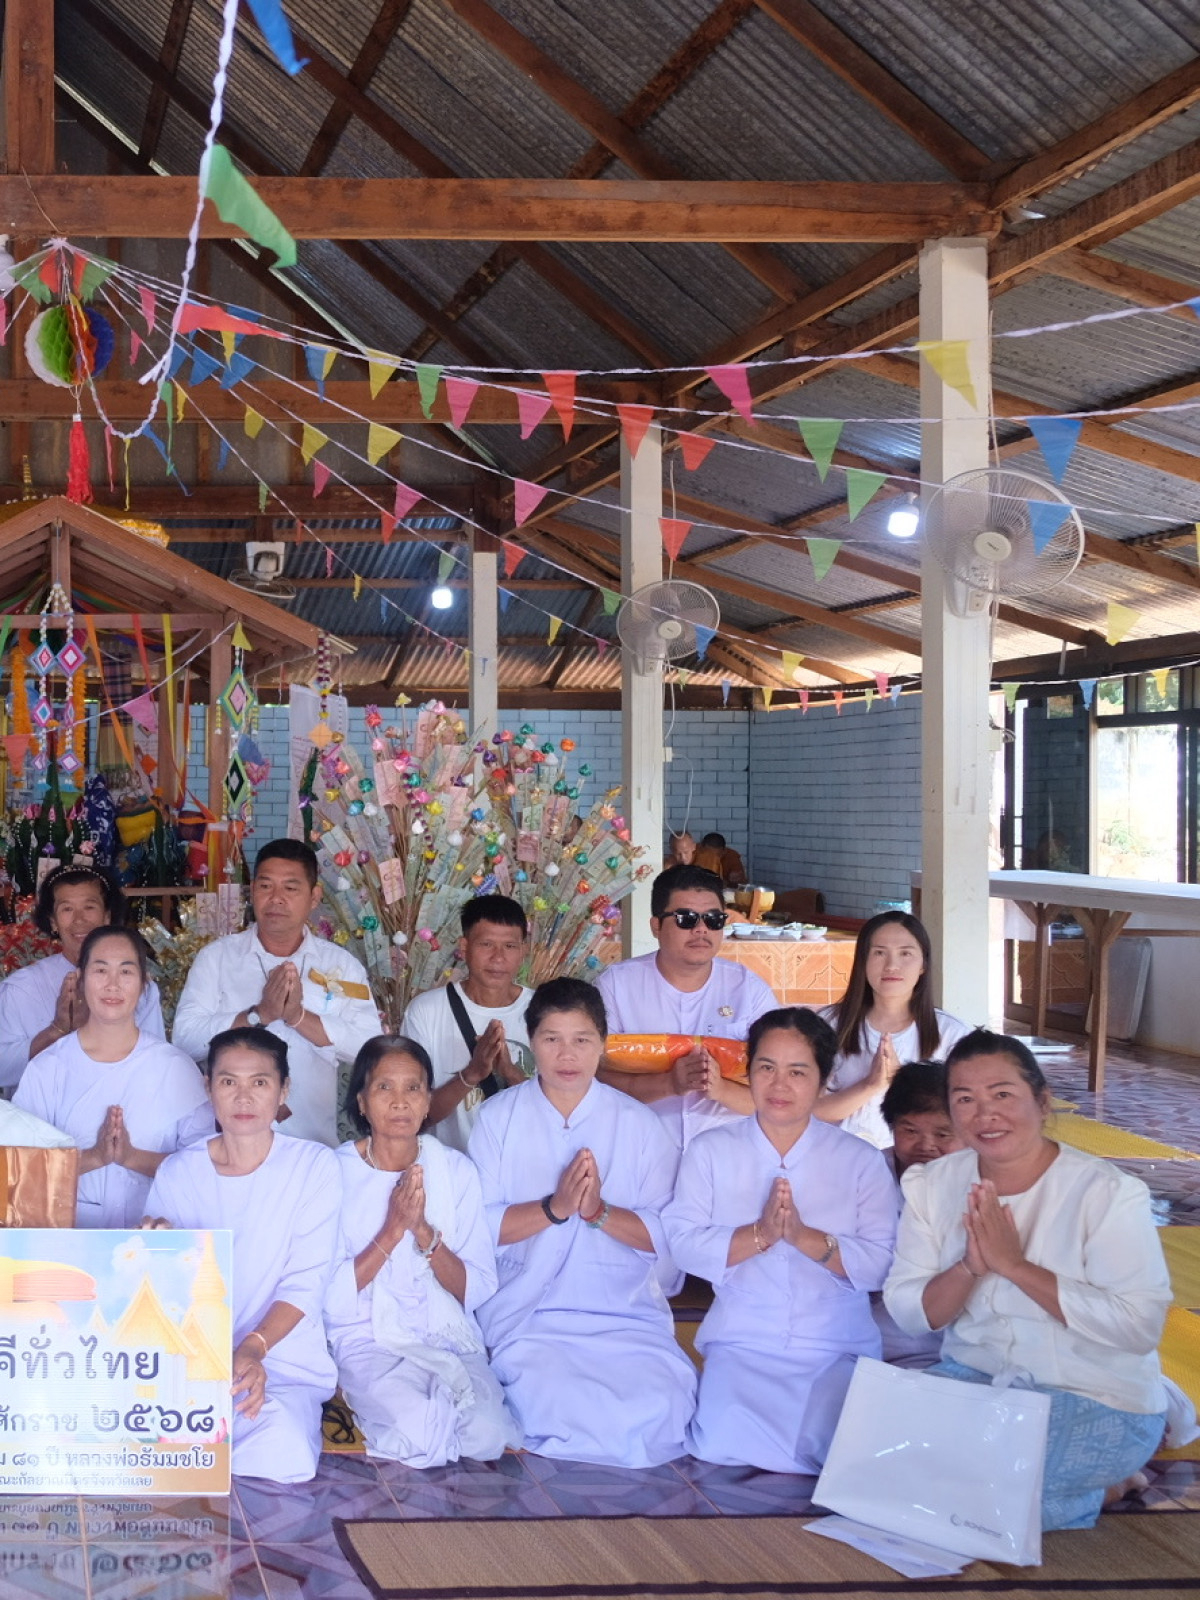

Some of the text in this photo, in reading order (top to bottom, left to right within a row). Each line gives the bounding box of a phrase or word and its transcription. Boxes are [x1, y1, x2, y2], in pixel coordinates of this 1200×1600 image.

[91, 1403, 215, 1433] ๒๕๖๘
[11, 1453, 40, 1467] ๘๑
[45, 1445, 61, 1467] ปี
[65, 1445, 215, 1468] หลวงพ่อธัมมชโย
